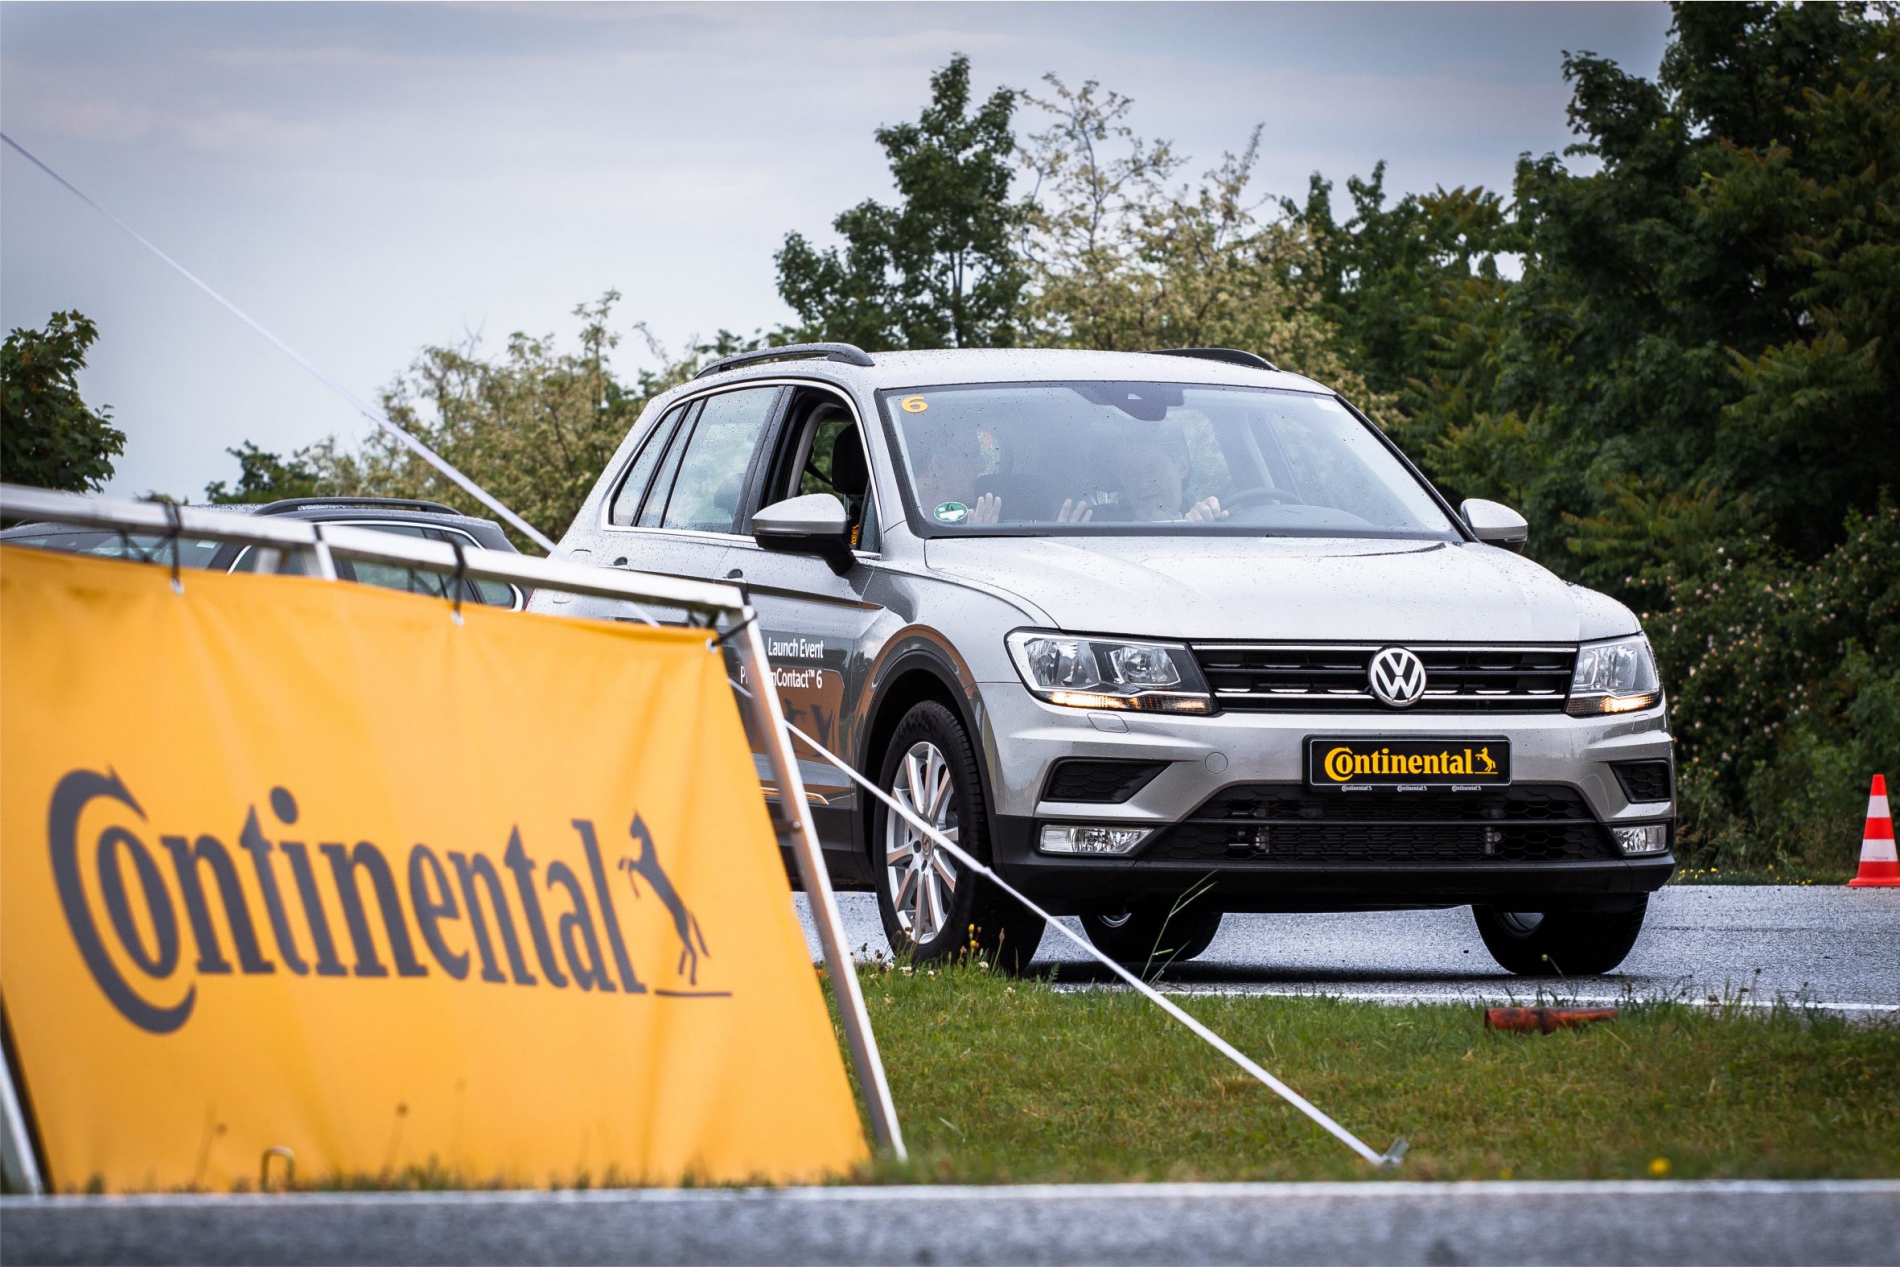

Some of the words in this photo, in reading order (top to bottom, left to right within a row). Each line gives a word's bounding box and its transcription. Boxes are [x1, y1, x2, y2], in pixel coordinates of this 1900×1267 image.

[901, 395, 929, 413] 6
[768, 637, 798, 658] Launch
[799, 638, 824, 659] Event
[816, 669, 823, 689] 6
[1324, 746, 1474, 782] Continental
[47, 764, 648, 1035] Continental
